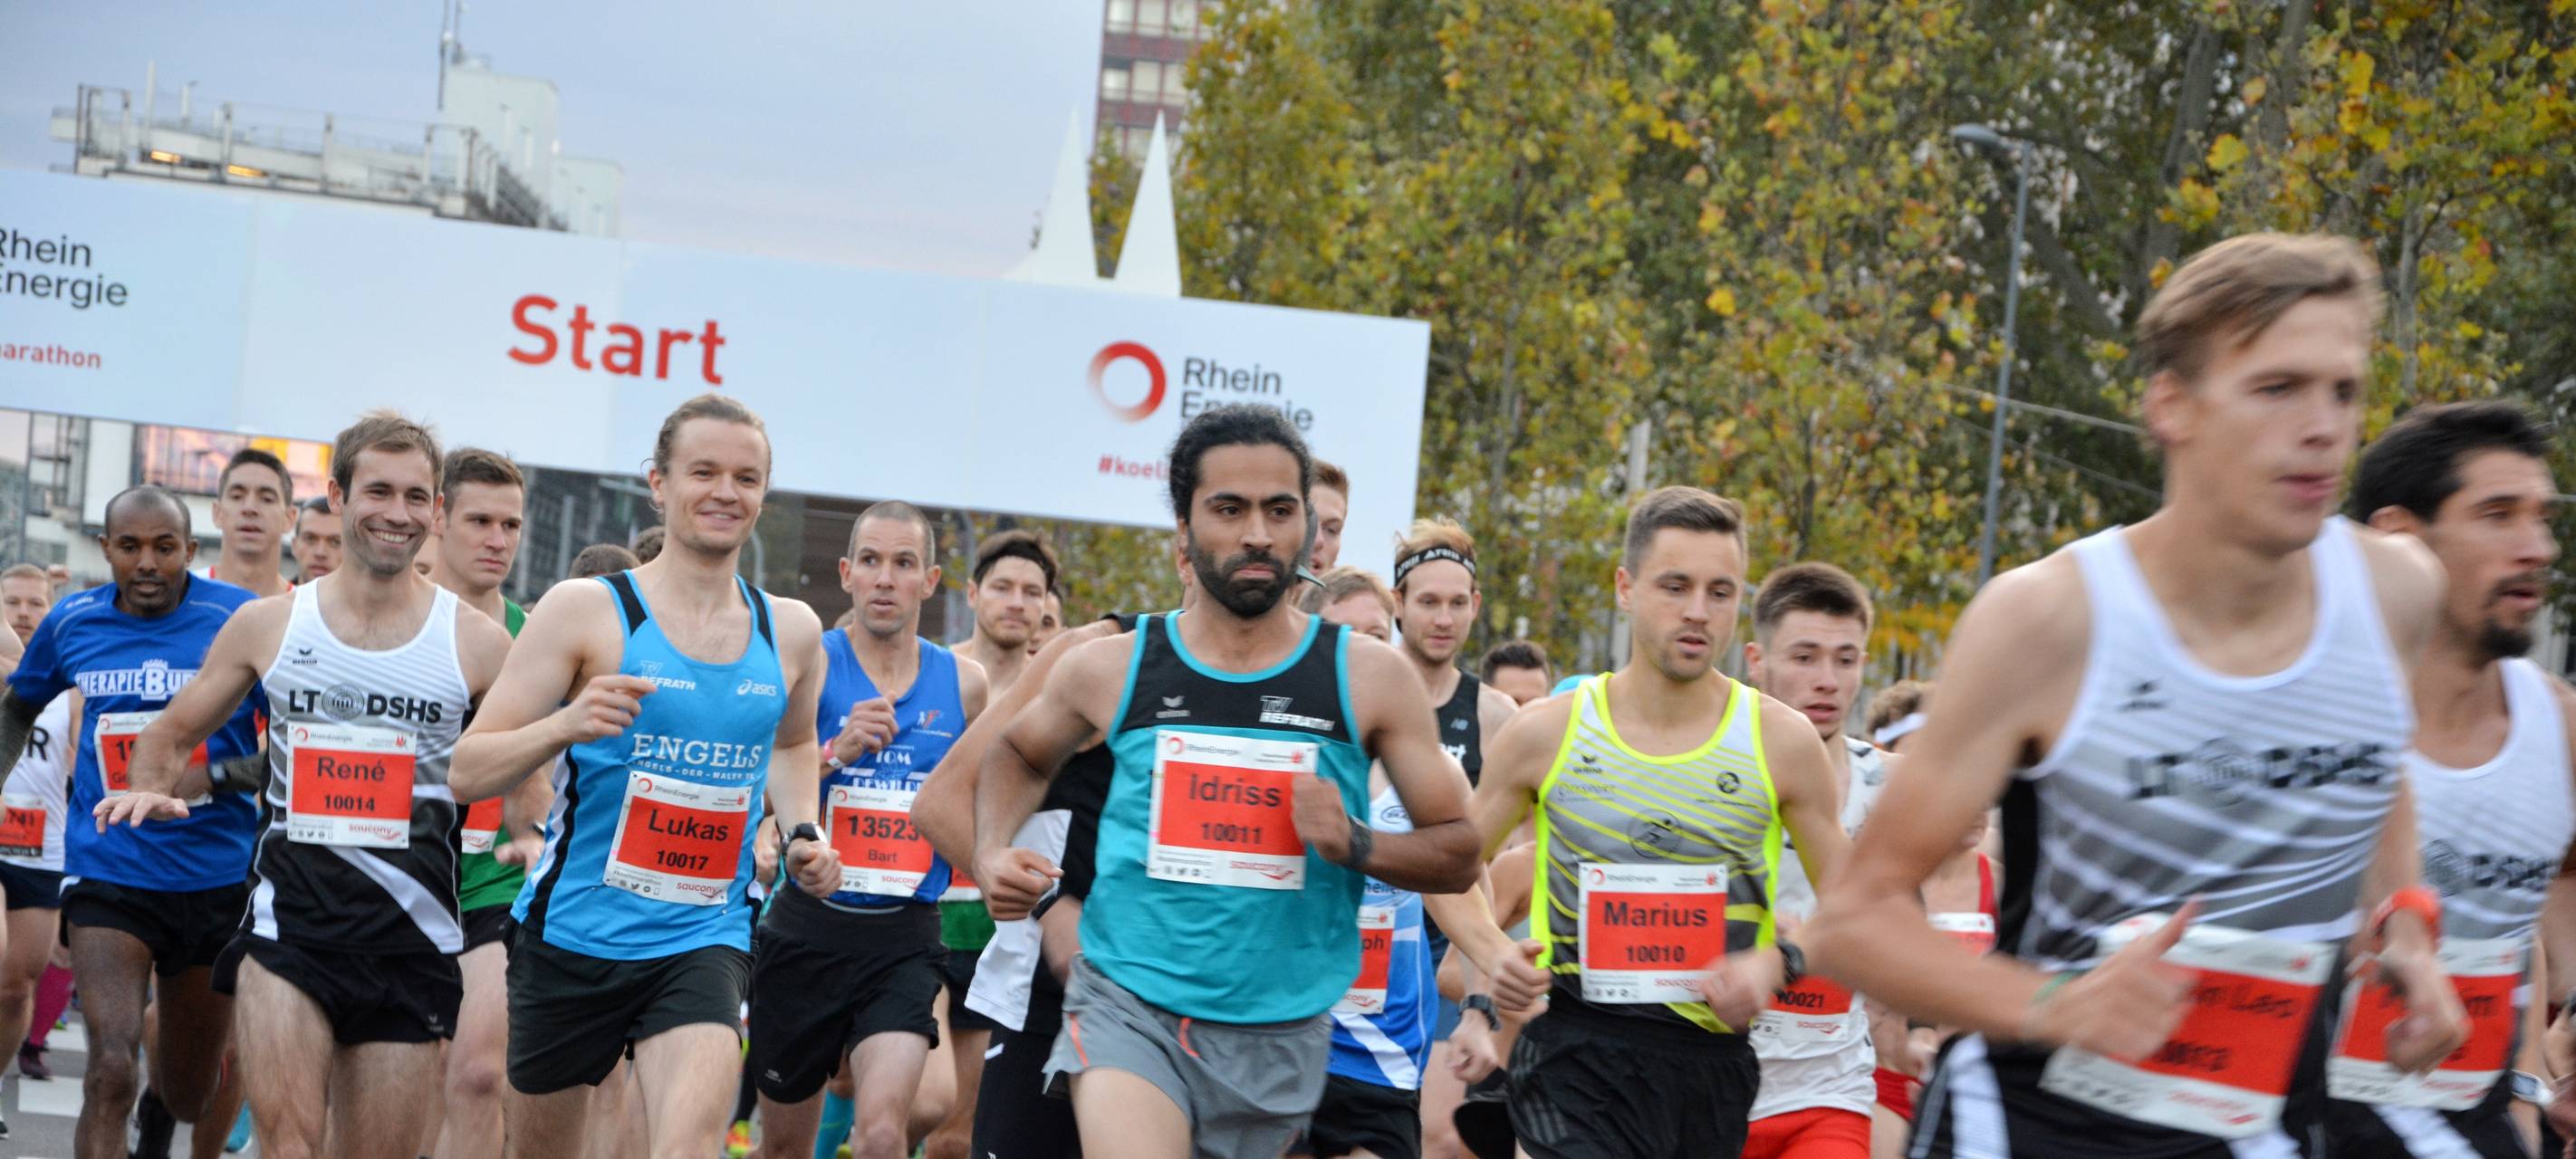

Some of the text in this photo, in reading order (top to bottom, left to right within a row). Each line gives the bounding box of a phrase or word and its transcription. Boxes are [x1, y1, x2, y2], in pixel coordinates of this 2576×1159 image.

[0, 263, 128, 310] nergie
[506, 293, 727, 386] Start
[0, 342, 102, 369] arathon
[1183, 356, 1282, 395] Rhein
[288, 689, 443, 723] LT DSHS
[631, 733, 764, 769] ENGELS
[317, 756, 386, 782] René
[324, 794, 375, 812] 10014
[1187, 773, 1283, 809] Idriss
[648, 809, 729, 842] Lukas
[1201, 821, 1263, 846] 10011
[657, 849, 710, 872] 10017
[868, 848, 898, 862] Bart
[1603, 901, 1708, 928] Marius
[1626, 944, 1686, 963] 10010
